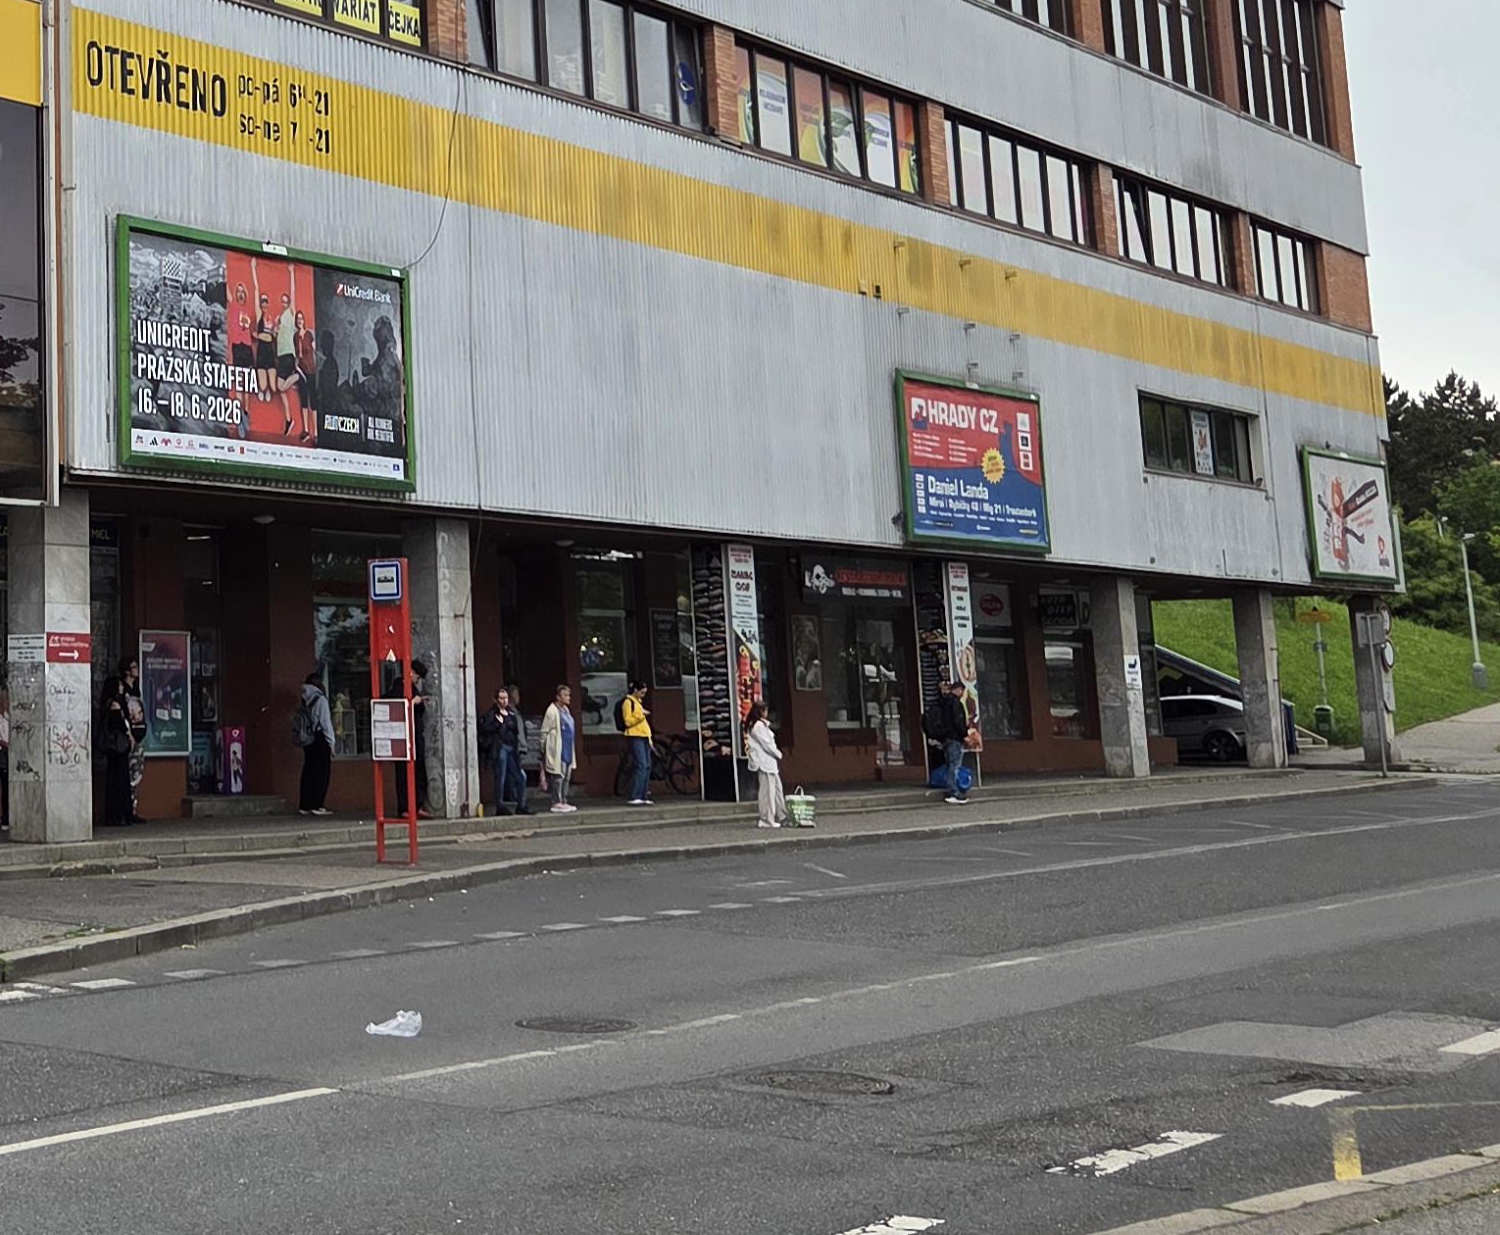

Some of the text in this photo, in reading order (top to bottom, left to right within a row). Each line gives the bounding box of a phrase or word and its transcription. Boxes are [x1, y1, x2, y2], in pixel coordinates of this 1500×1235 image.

[388, 6, 420, 38] ČEJKA
[86, 40, 227, 118] OTEVŘENO
[239, 113, 281, 142] so-ne
[344, 285, 392, 303] UniCredit Bank
[137, 319, 212, 353] UNICREDIT
[137, 350, 259, 393] PRAŽSKÁ ŠTAFETA
[191, 394, 205, 420] 6.
[207, 396, 241, 425] 2026
[928, 399, 999, 434] HRADY CZ
[927, 475, 989, 500] Daniel Landa
